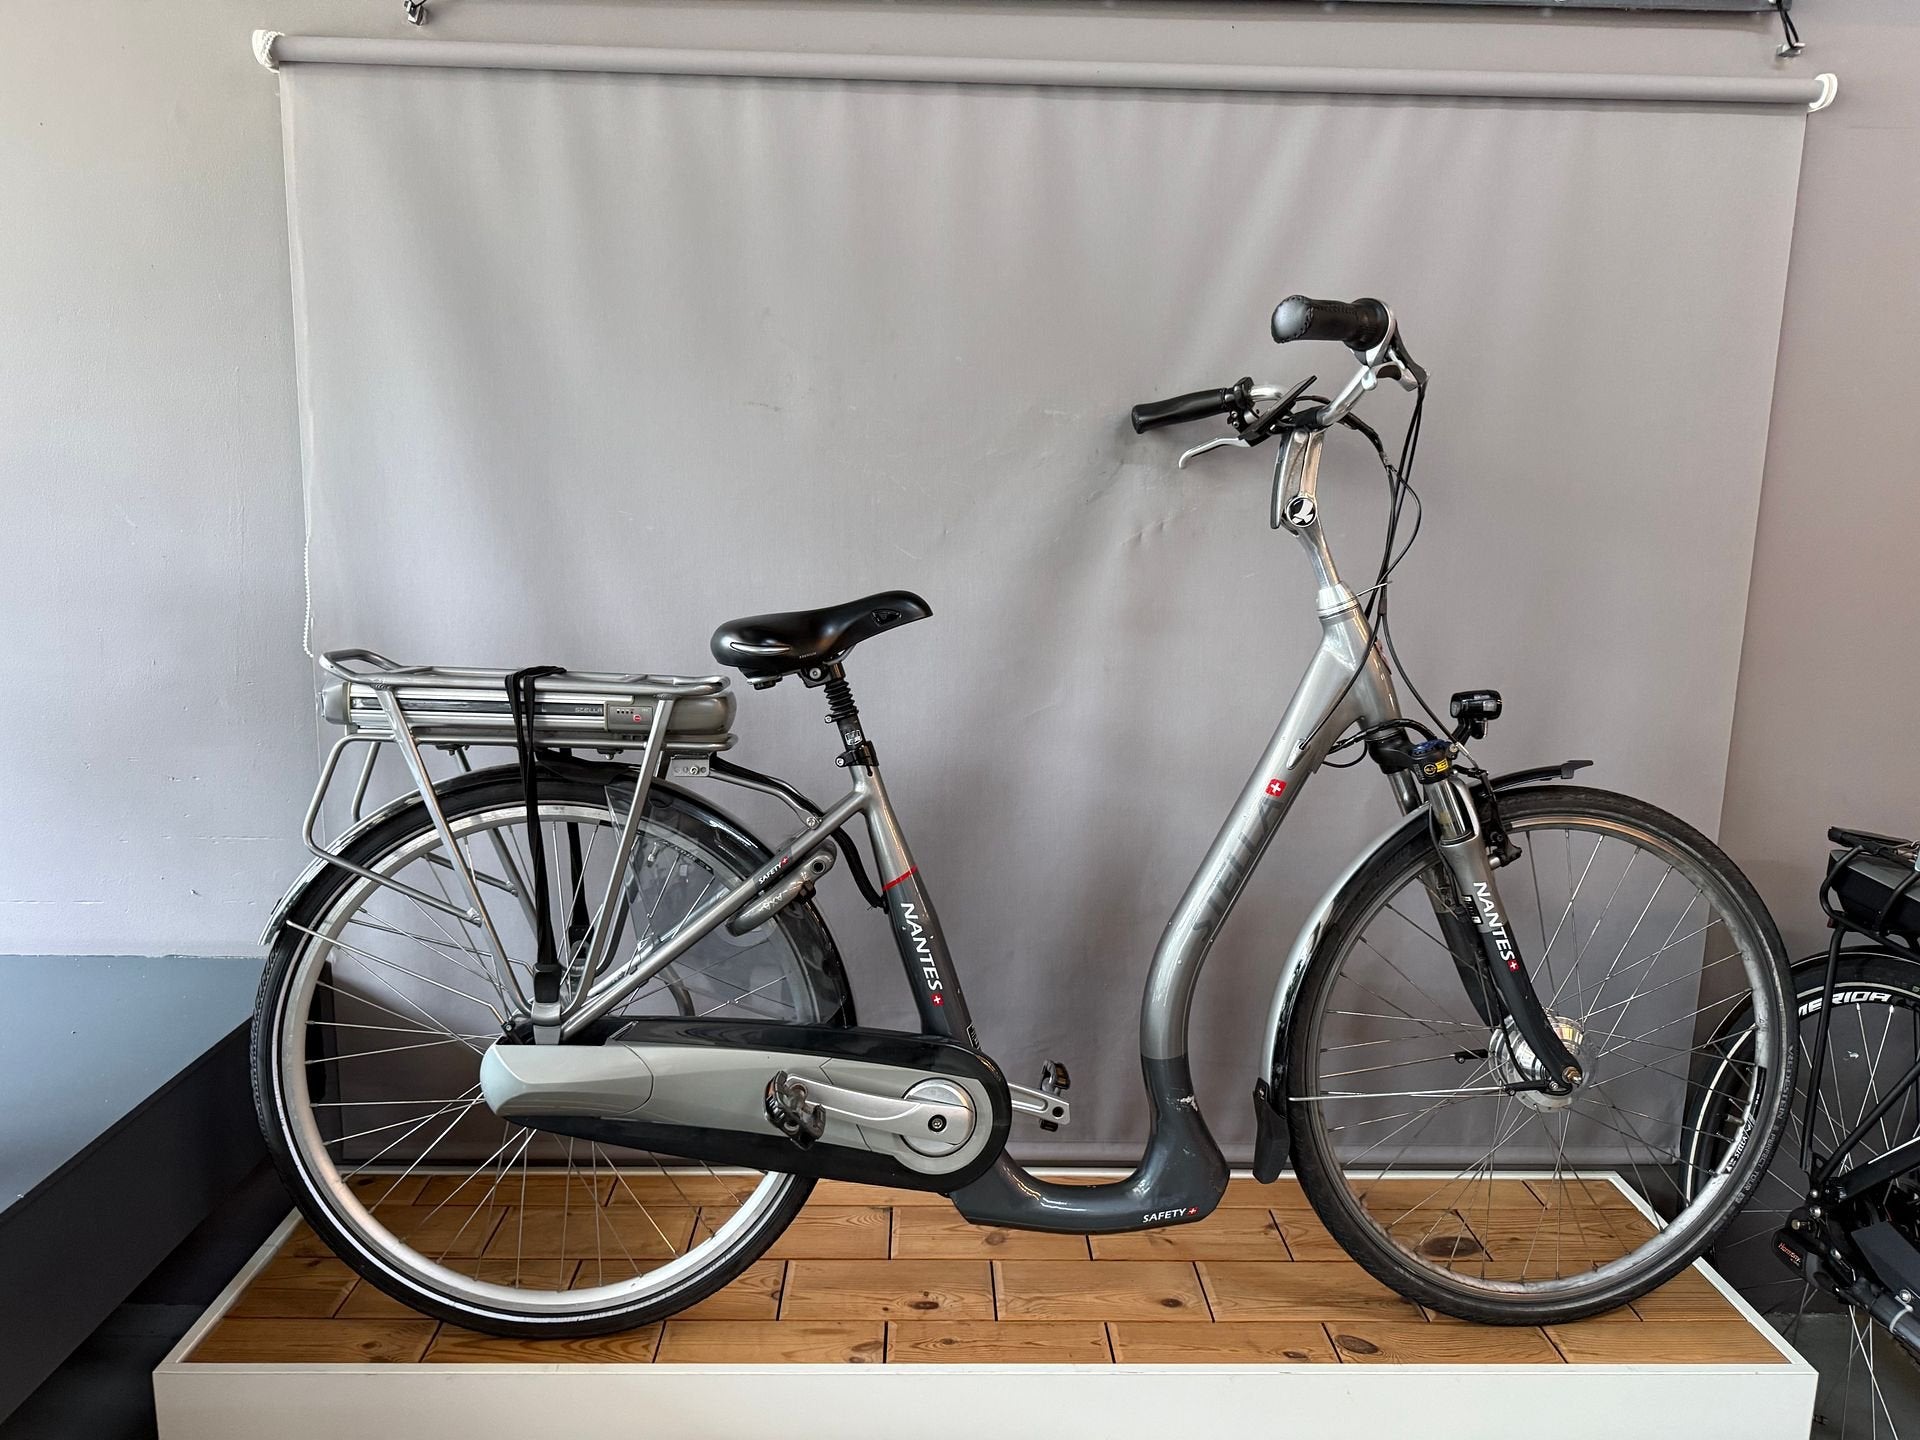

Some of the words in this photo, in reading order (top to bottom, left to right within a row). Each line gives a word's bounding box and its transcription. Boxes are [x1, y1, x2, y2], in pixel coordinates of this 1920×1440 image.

[574, 706, 603, 714] STELLA
[758, 861, 782, 884] SAFETY
[1473, 881, 1516, 962] NANTES
[900, 902, 943, 991] NANTES
[1777, 1044, 1795, 1120] VREDESTEIN
[1734, 1135, 1748, 1159] STELLA
[1758, 1133, 1776, 1168] PERFECT
[1743, 1170, 1760, 1191] TOUR
[1141, 1207, 1187, 1223] SAFETY
